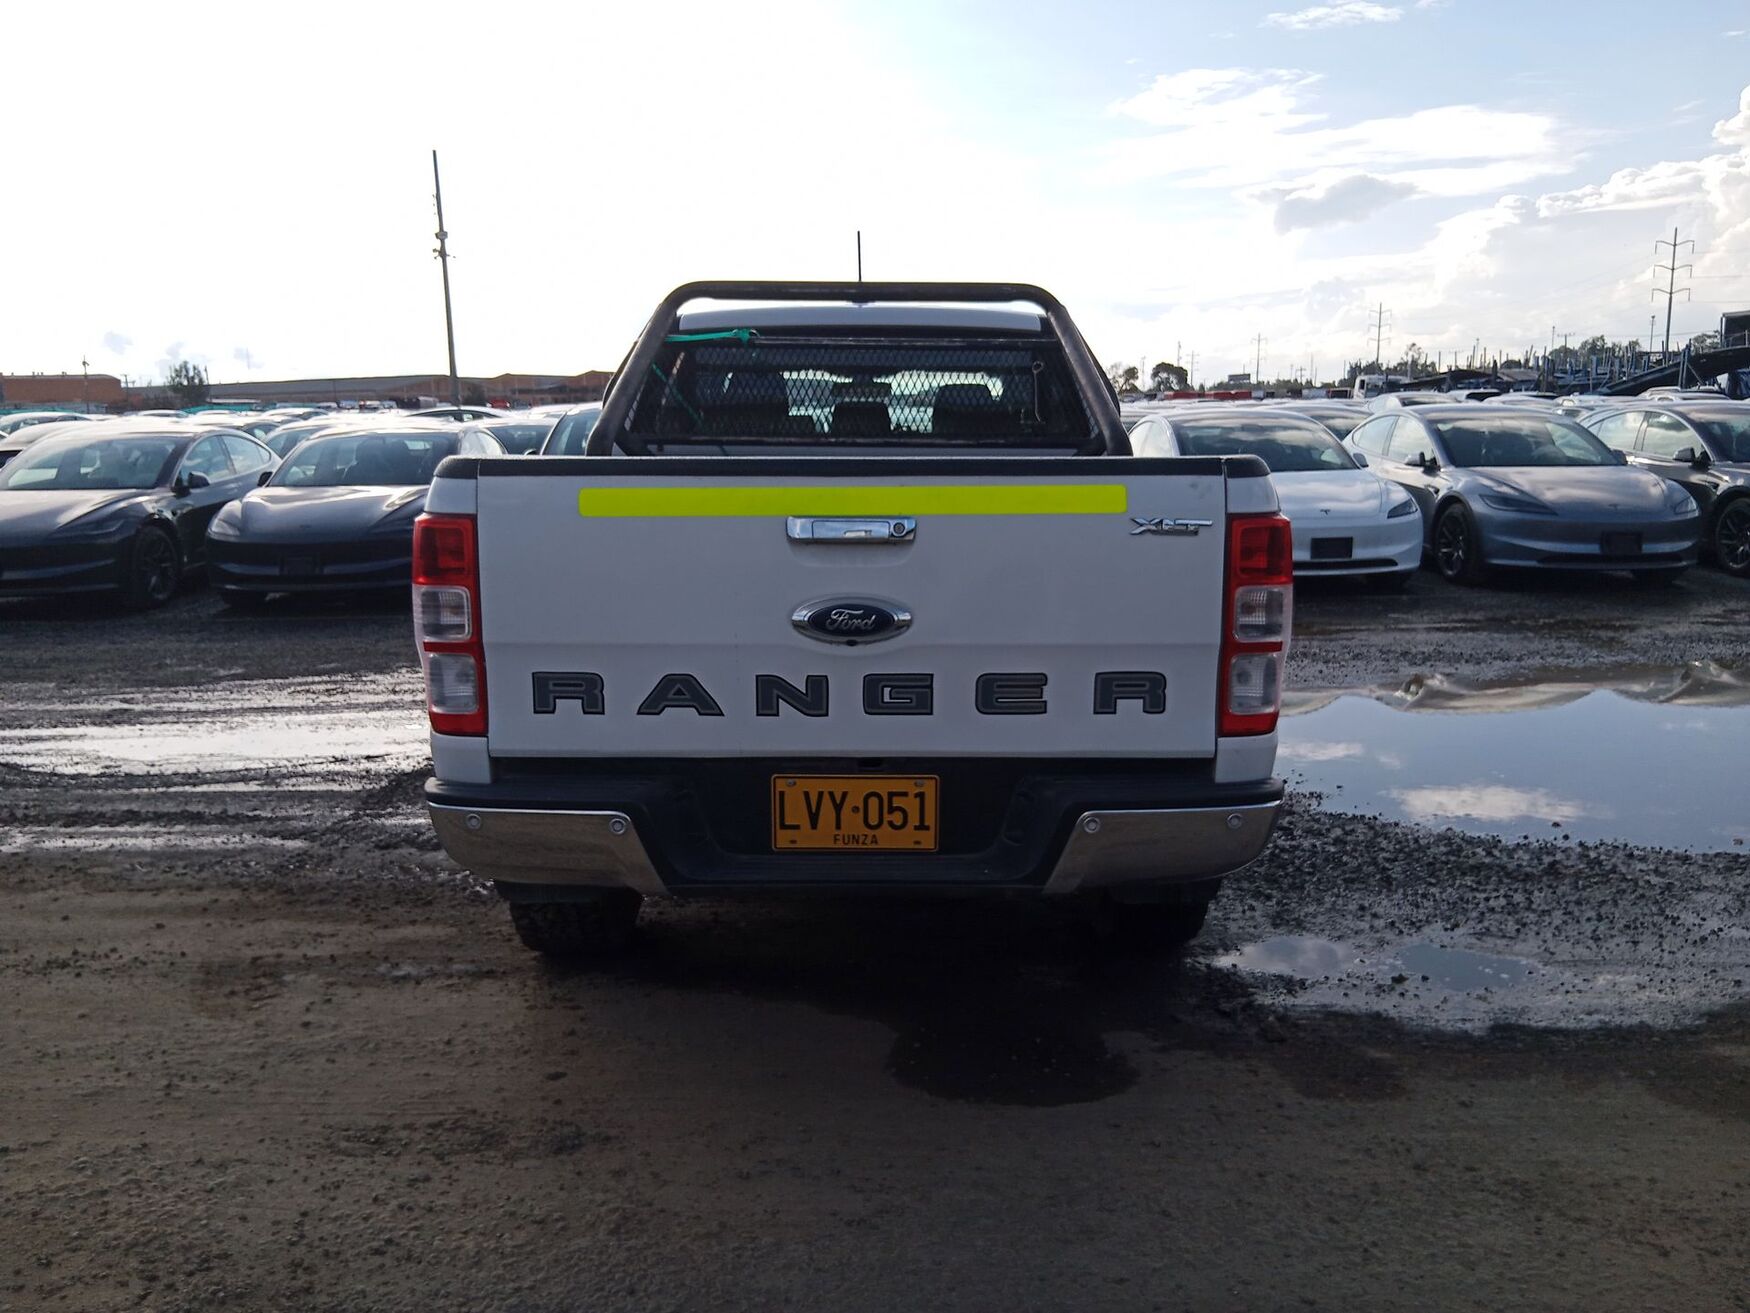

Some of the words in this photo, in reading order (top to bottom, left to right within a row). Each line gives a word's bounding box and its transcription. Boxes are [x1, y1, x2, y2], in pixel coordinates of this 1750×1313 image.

[825, 608, 877, 630] Ford
[532, 671, 1167, 717] RANGER
[833, 834, 879, 846] FUNZA
